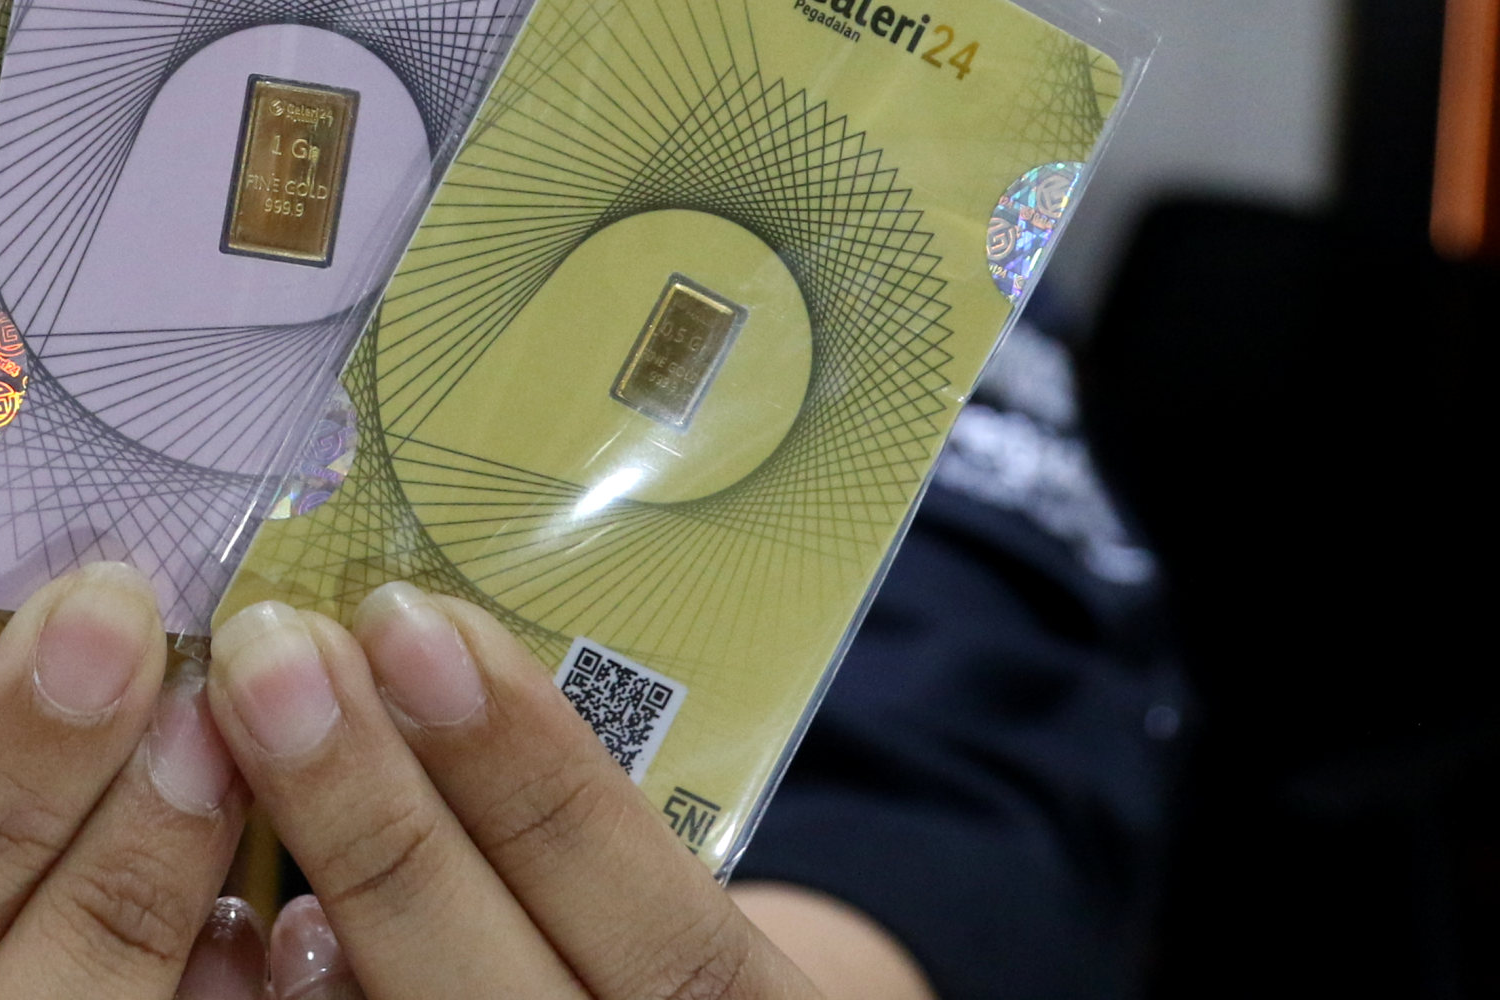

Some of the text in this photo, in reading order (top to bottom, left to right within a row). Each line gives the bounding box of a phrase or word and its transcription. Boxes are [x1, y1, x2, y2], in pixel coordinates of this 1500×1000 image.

[245, 172, 329, 201] FINE GOLD
[263, 196, 304, 218] 999.9
